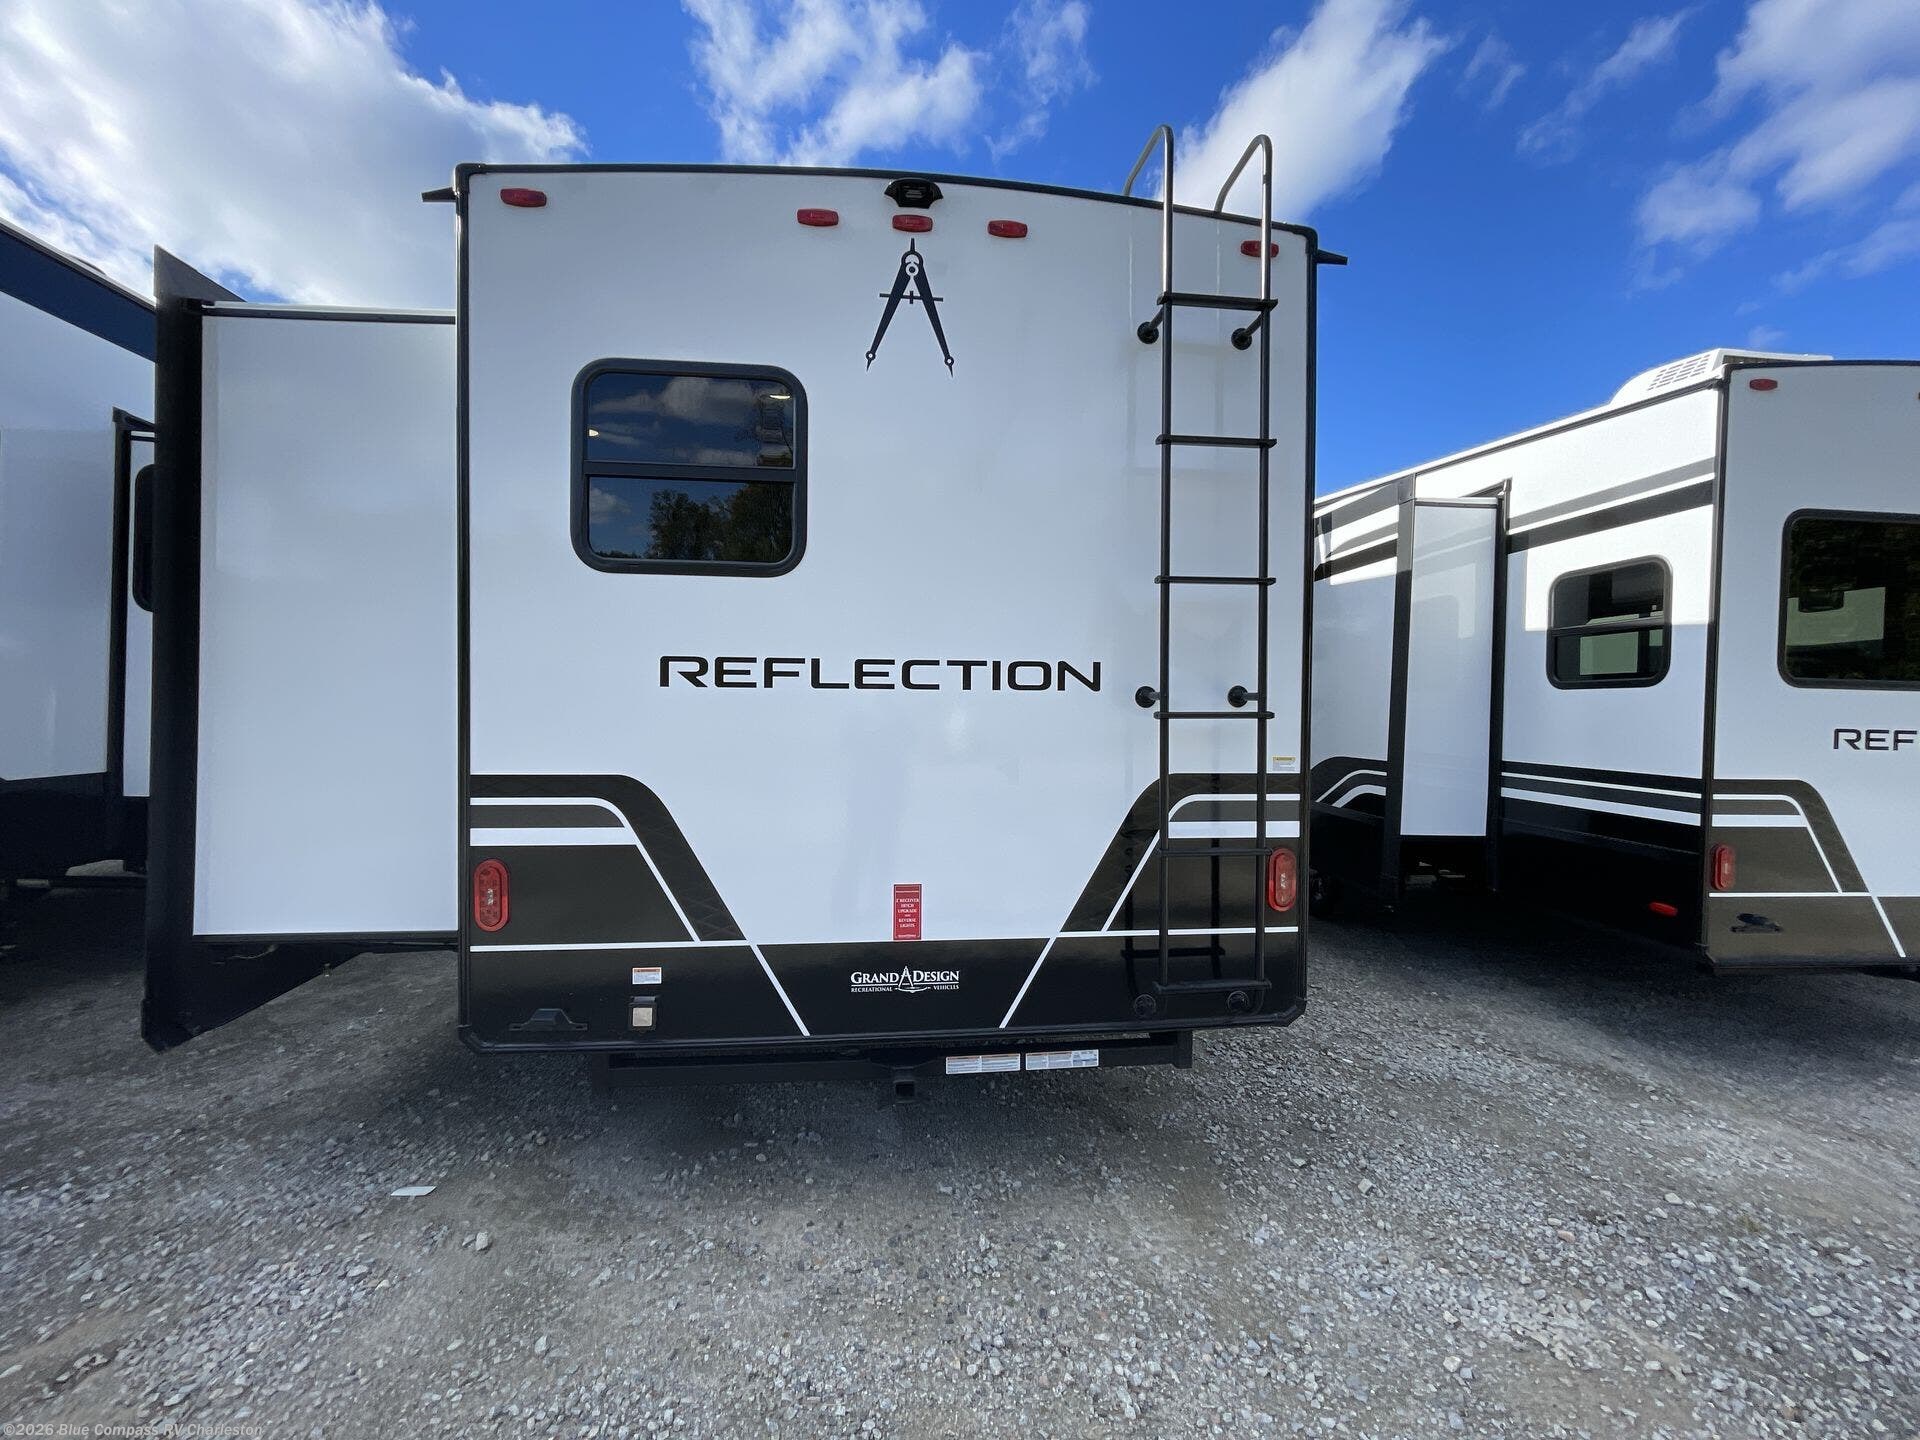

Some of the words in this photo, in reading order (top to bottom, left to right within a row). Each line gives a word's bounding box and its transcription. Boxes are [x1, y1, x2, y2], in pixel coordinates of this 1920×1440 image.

[659, 655, 1102, 692] REFLECTION
[1833, 728, 1918, 751] REF
[912, 970, 960, 983] DESIGN
